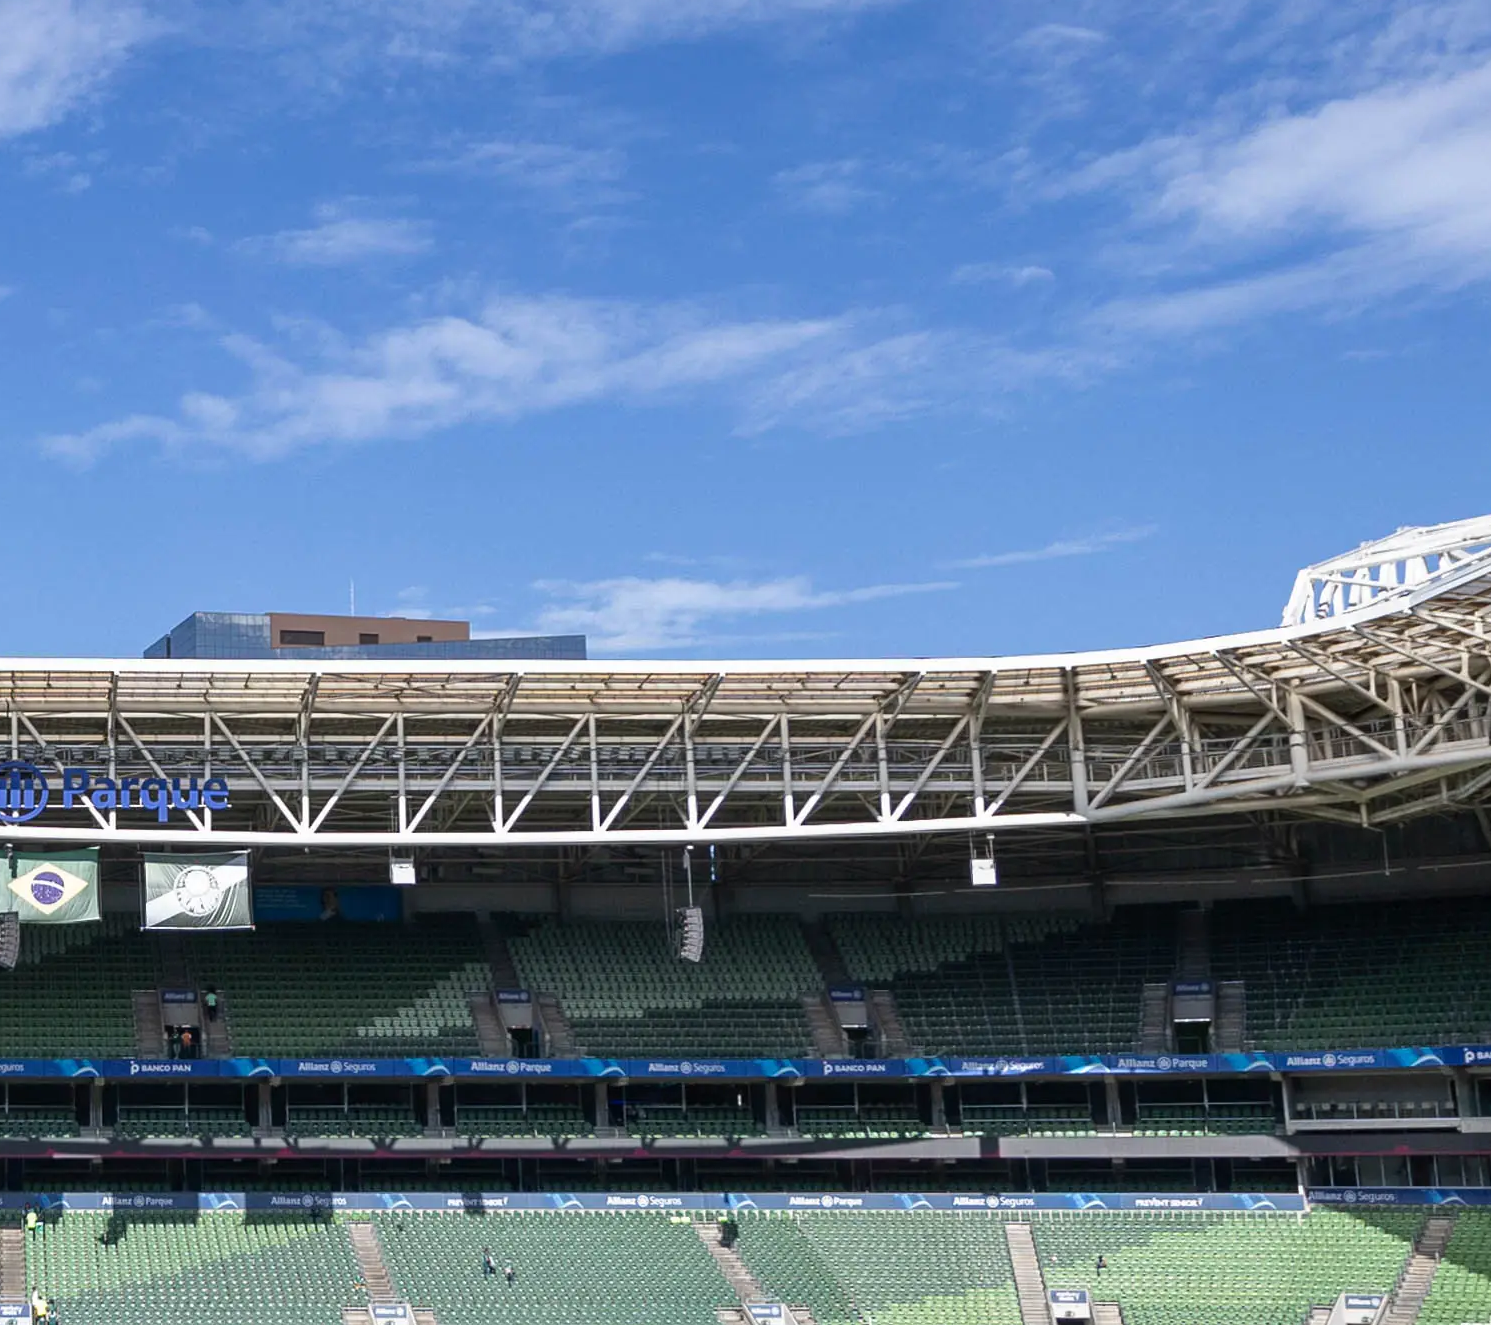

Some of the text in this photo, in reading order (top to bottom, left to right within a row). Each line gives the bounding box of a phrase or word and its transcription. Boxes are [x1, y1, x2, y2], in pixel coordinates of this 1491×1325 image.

[63, 766, 230, 823] Parque
[142, 1064, 192, 1073] BANCO PAN
[298, 1061, 376, 1075] Allianz Seguros
[1118, 1057, 1208, 1072] Allianz Parque
[953, 1195, 1035, 1209] Allianz Seguros
